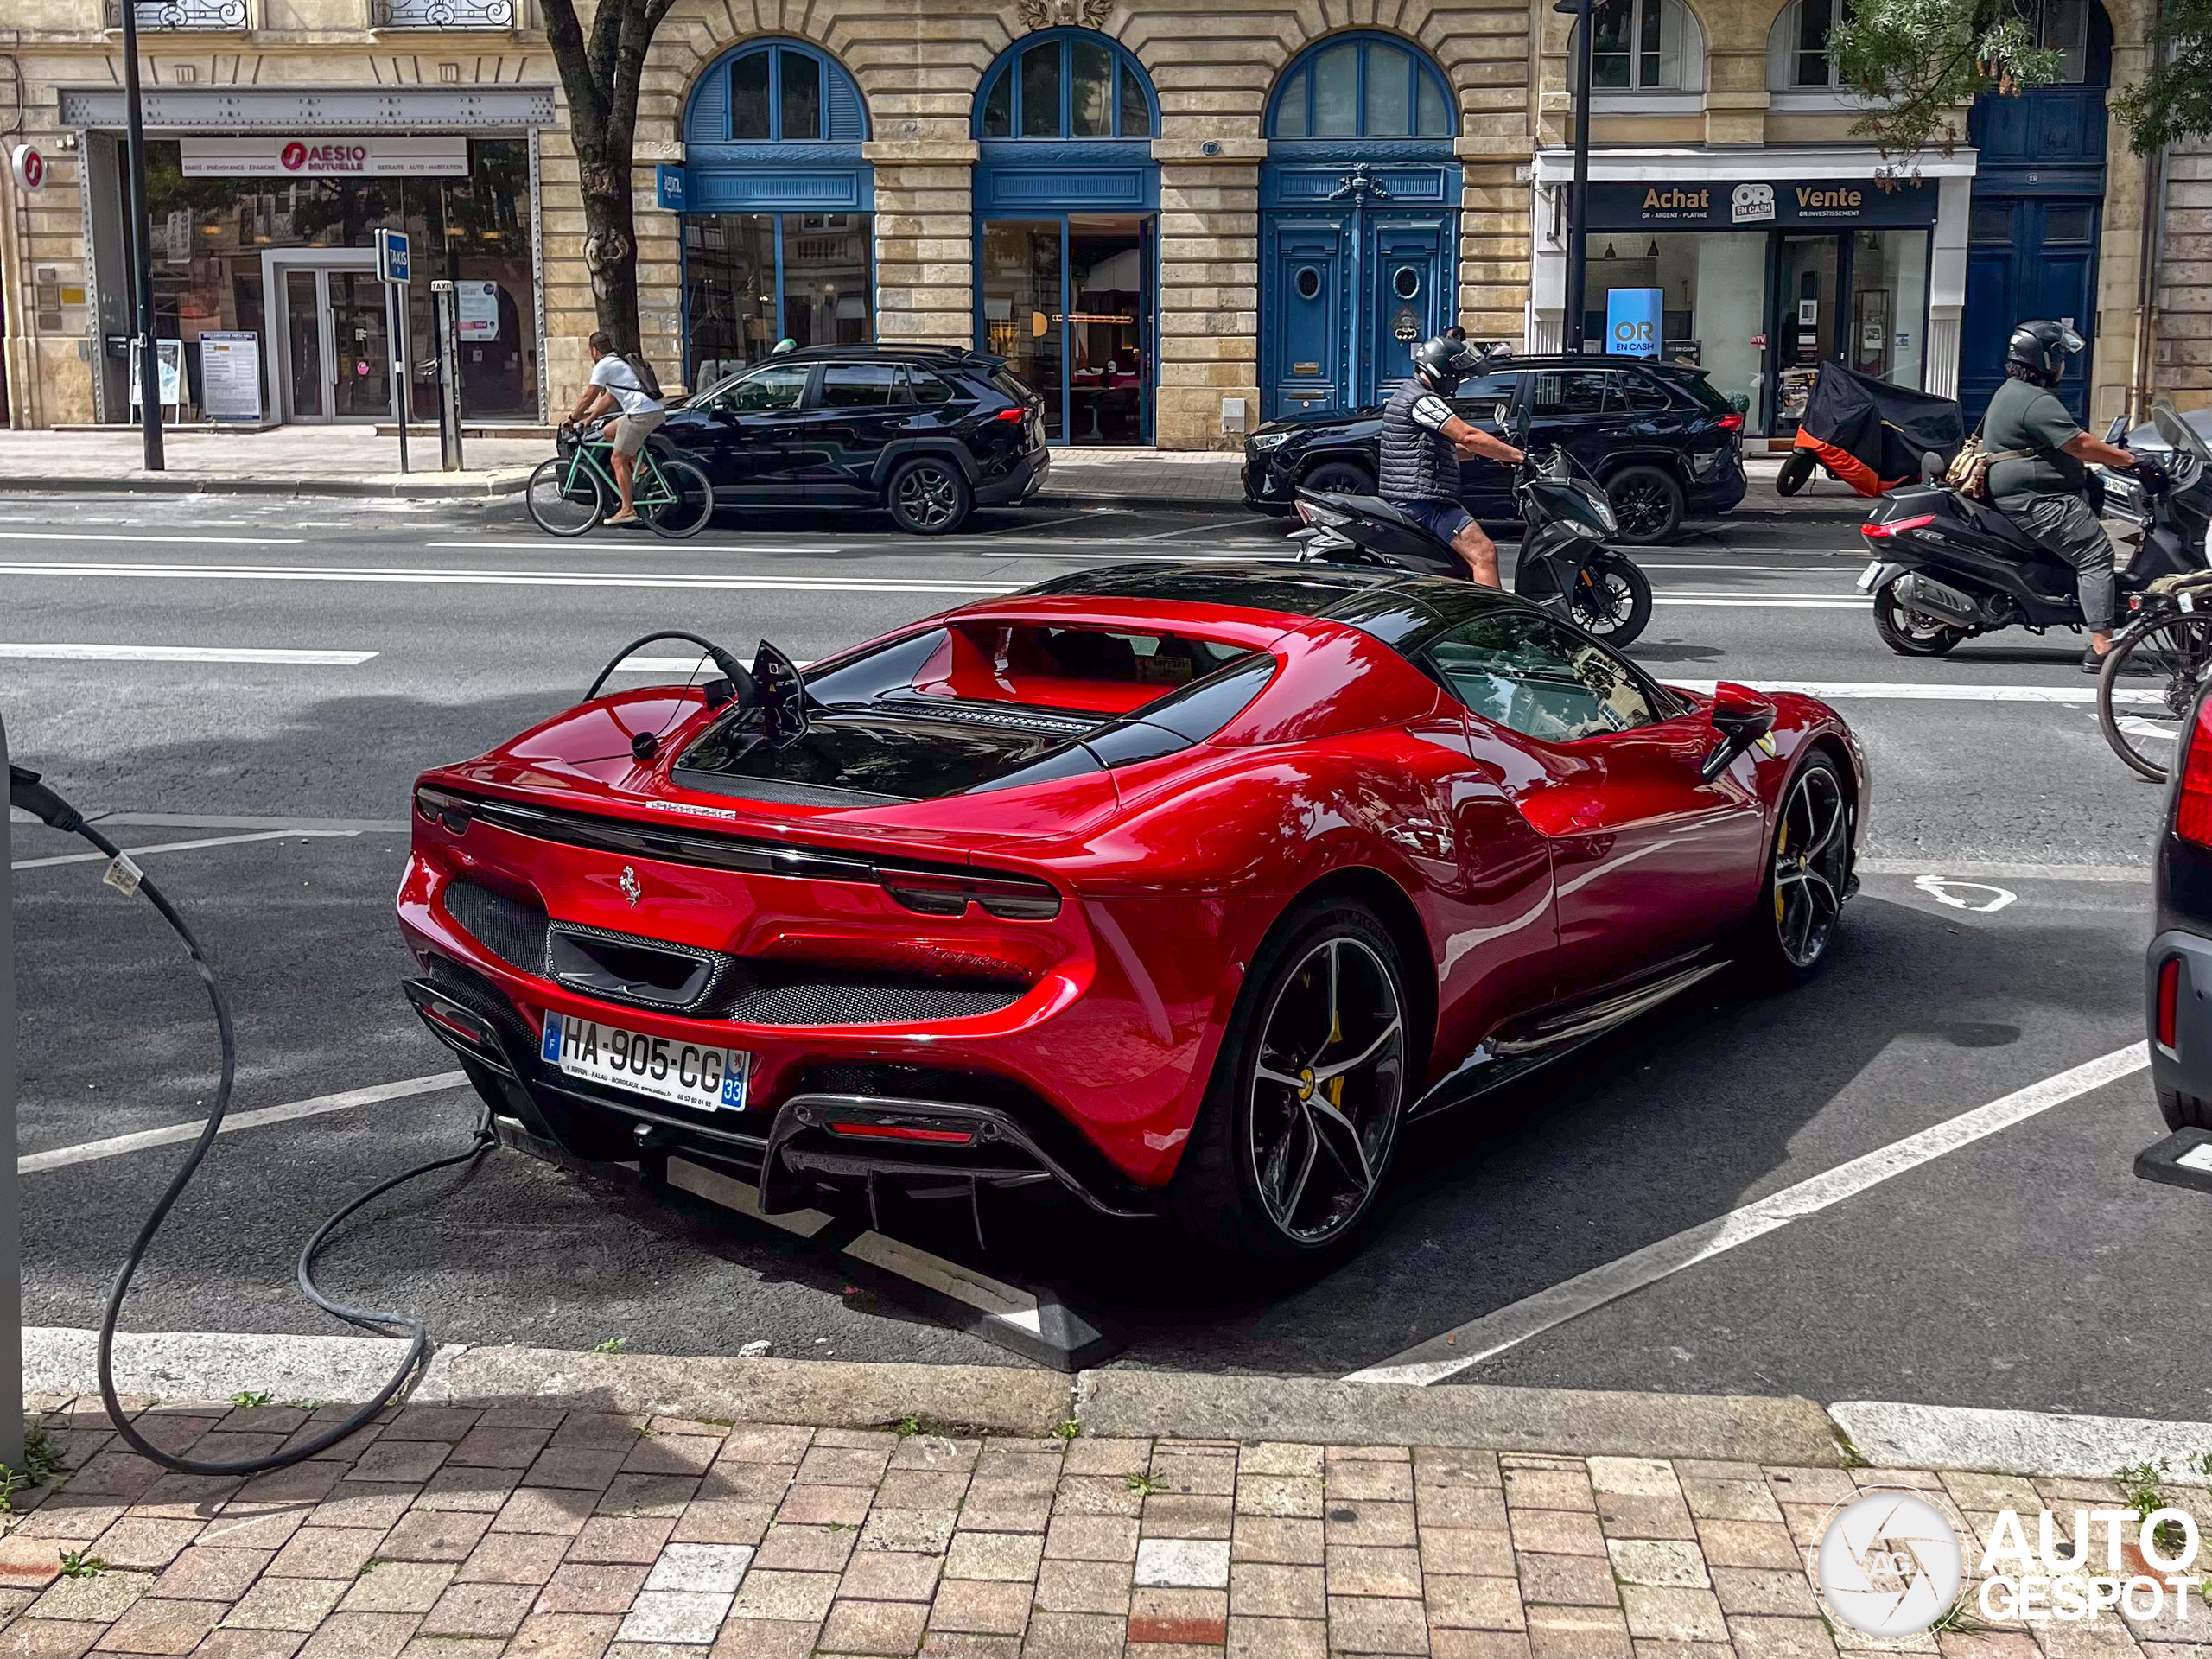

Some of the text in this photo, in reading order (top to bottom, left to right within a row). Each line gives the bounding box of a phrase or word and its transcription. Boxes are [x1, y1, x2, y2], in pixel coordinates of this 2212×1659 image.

[308, 162, 363, 171] MUTUELLE
[1643, 188, 1710, 209] Achat
[1735, 185, 1772, 206] OR
[1796, 187, 1862, 207] Vente
[1737, 206, 1748, 215] EN
[389, 248, 407, 266] TAXIS
[1614, 321, 1654, 342] OR
[549, 1038, 556, 1051] F
[563, 1016, 721, 1094] HA-905-CG
[591, 1071, 608, 1081] PALAU
[611, 1077, 639, 1089] BORDEAUX
[723, 1078, 742, 1102] 33
